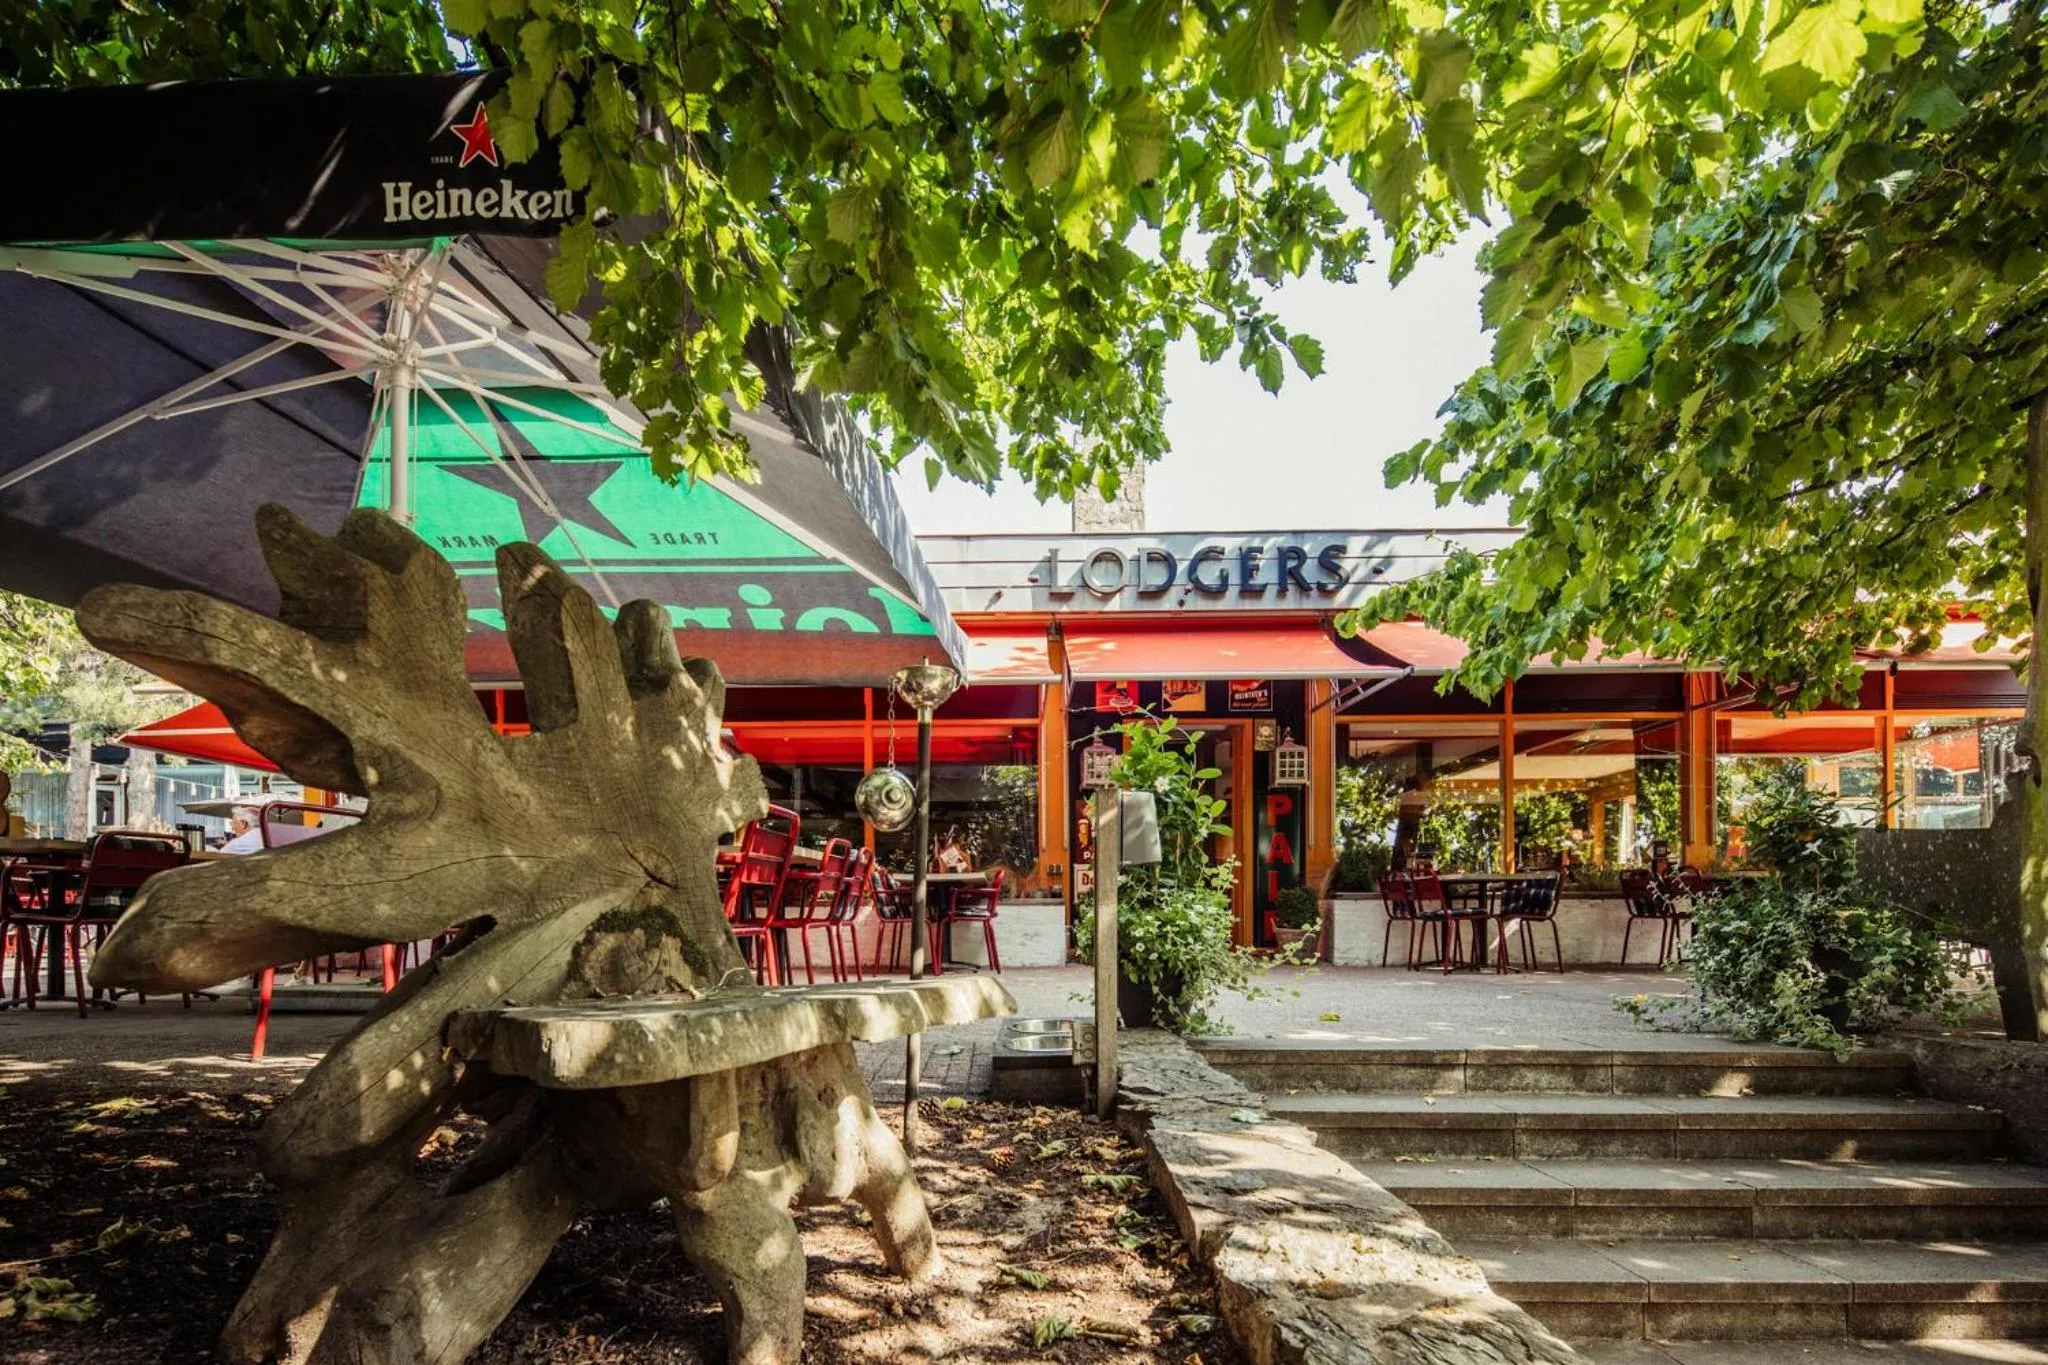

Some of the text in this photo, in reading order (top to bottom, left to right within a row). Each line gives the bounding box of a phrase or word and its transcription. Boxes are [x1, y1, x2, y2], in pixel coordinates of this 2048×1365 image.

[382, 177, 575, 223] Heineken
[1048, 545, 1351, 596] LODGERS
[1263, 794, 1295, 941] PAI
